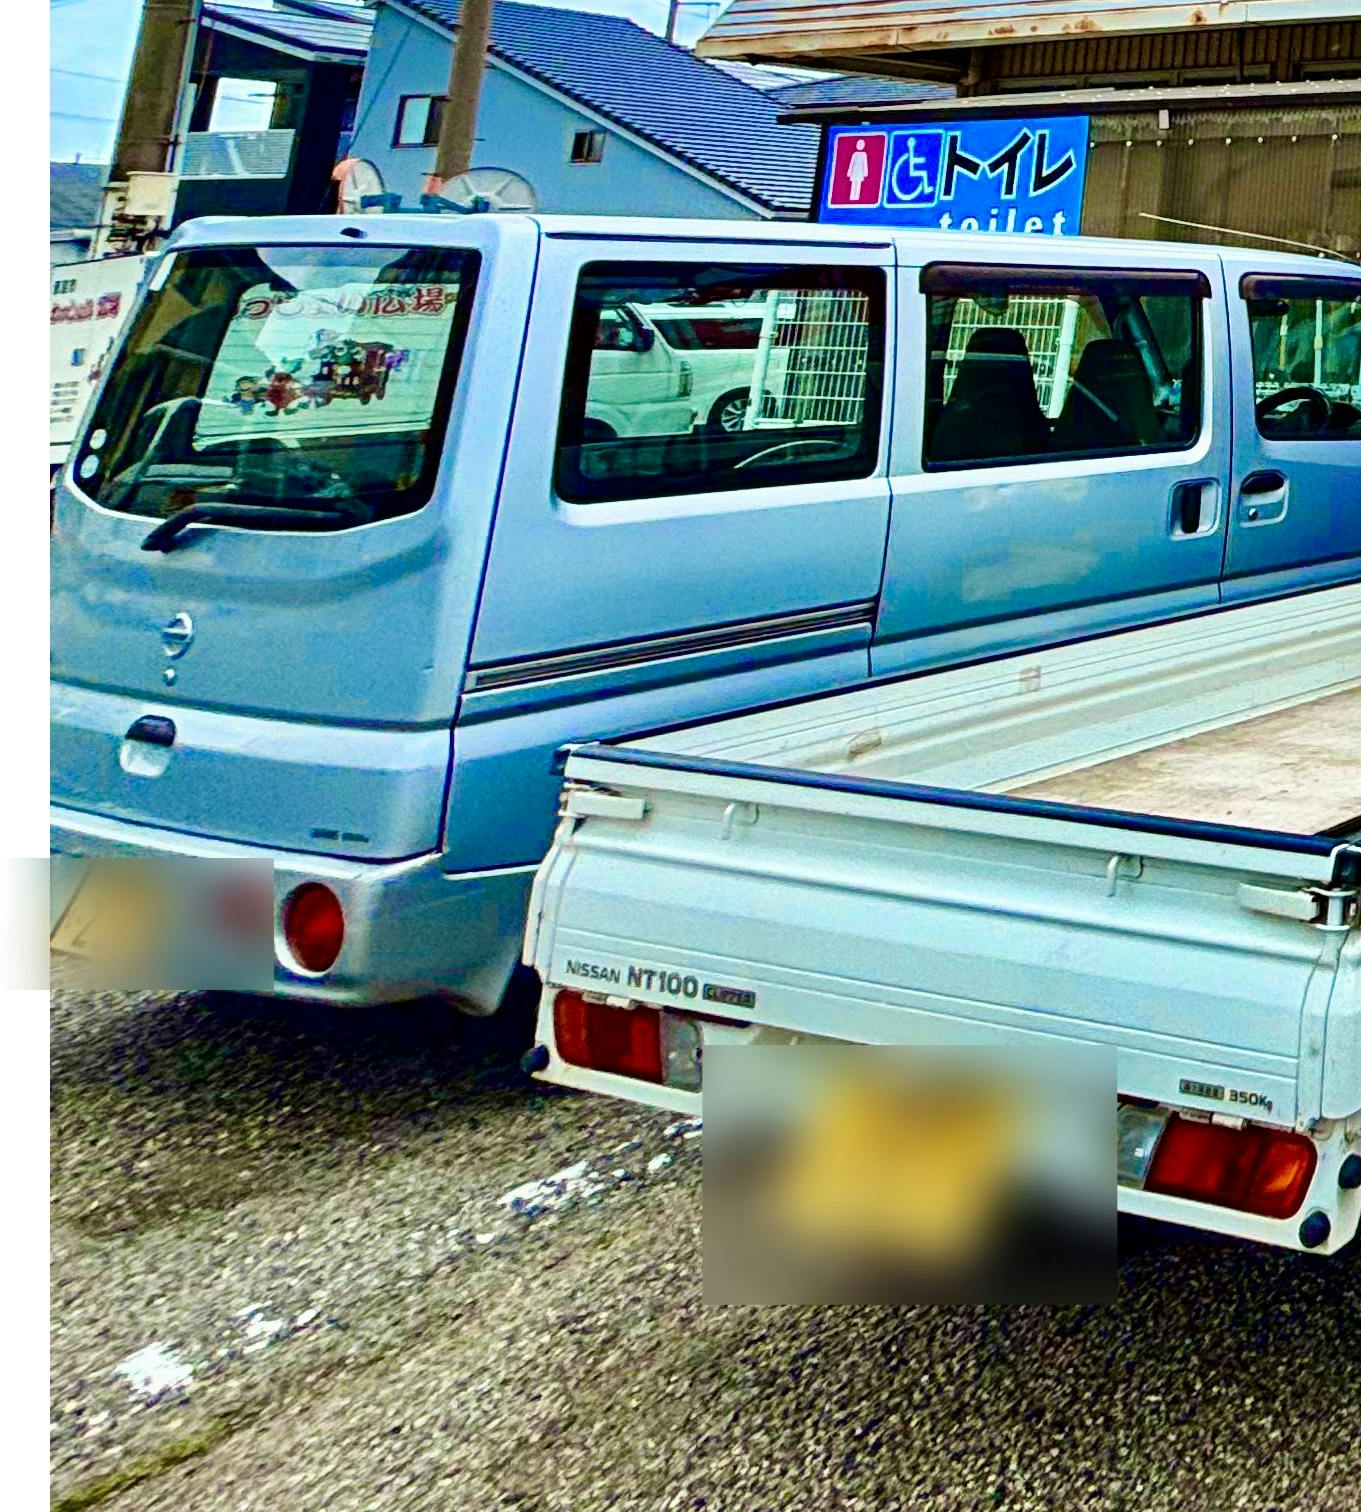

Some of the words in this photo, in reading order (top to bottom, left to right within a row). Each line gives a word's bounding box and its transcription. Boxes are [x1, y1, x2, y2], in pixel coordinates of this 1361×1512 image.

[942, 128, 1076, 201] トイレ
[939, 207, 1066, 235] toilet
[565, 959, 622, 985] NISSAN
[626, 964, 700, 999] NT100
